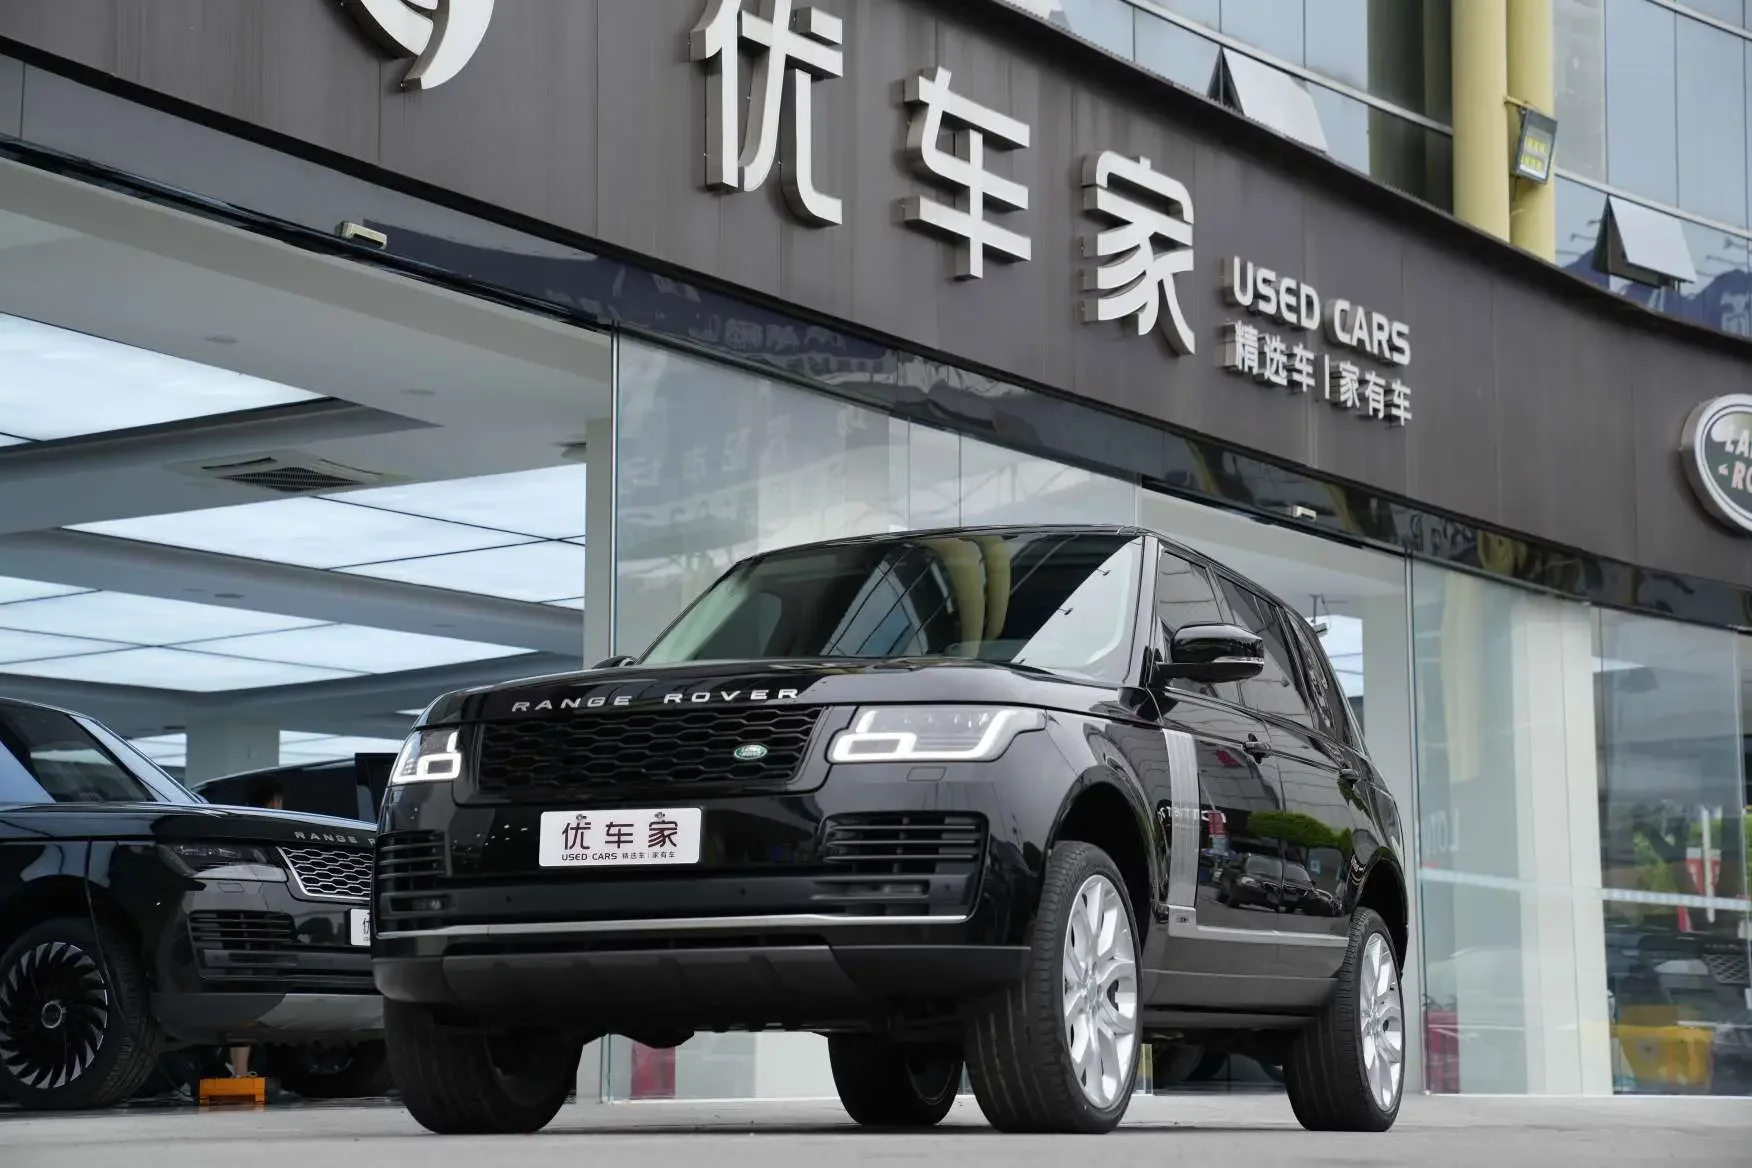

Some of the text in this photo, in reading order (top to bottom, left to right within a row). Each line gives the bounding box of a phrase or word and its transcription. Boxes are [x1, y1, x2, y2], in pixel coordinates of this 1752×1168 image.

[694, 0, 1196, 356] 优车家
[1233, 255, 1412, 366] USED CARS
[511, 688, 799, 712] RANGE ROVER
[294, 831, 358, 844] RANGE
[561, 819, 678, 850] 优车家
[561, 852, 588, 861] USED
[591, 852, 618, 861] CARS
